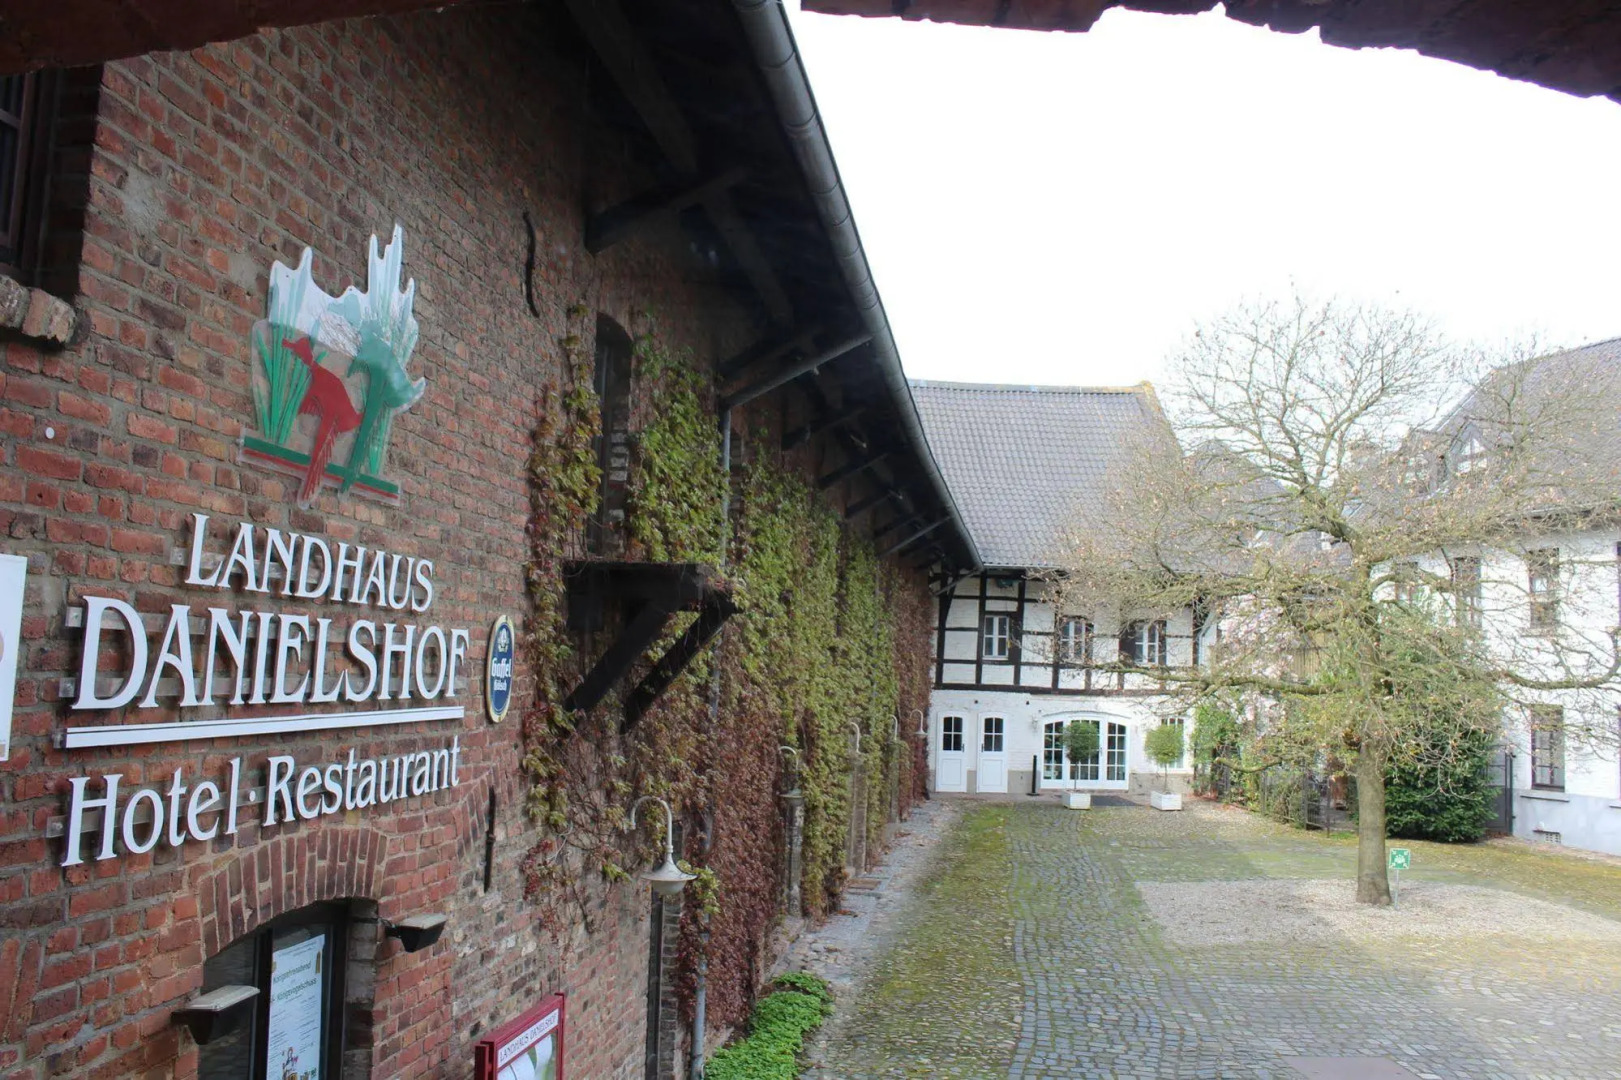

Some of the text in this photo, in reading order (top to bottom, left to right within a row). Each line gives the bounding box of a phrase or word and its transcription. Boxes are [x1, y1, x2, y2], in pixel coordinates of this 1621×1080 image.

[185, 513, 433, 612] LANDHAUS
[71, 595, 470, 710] DANIELSHOF
[491, 657, 512, 679] Gaffel
[60, 735, 461, 867] Hotel Restaurant
